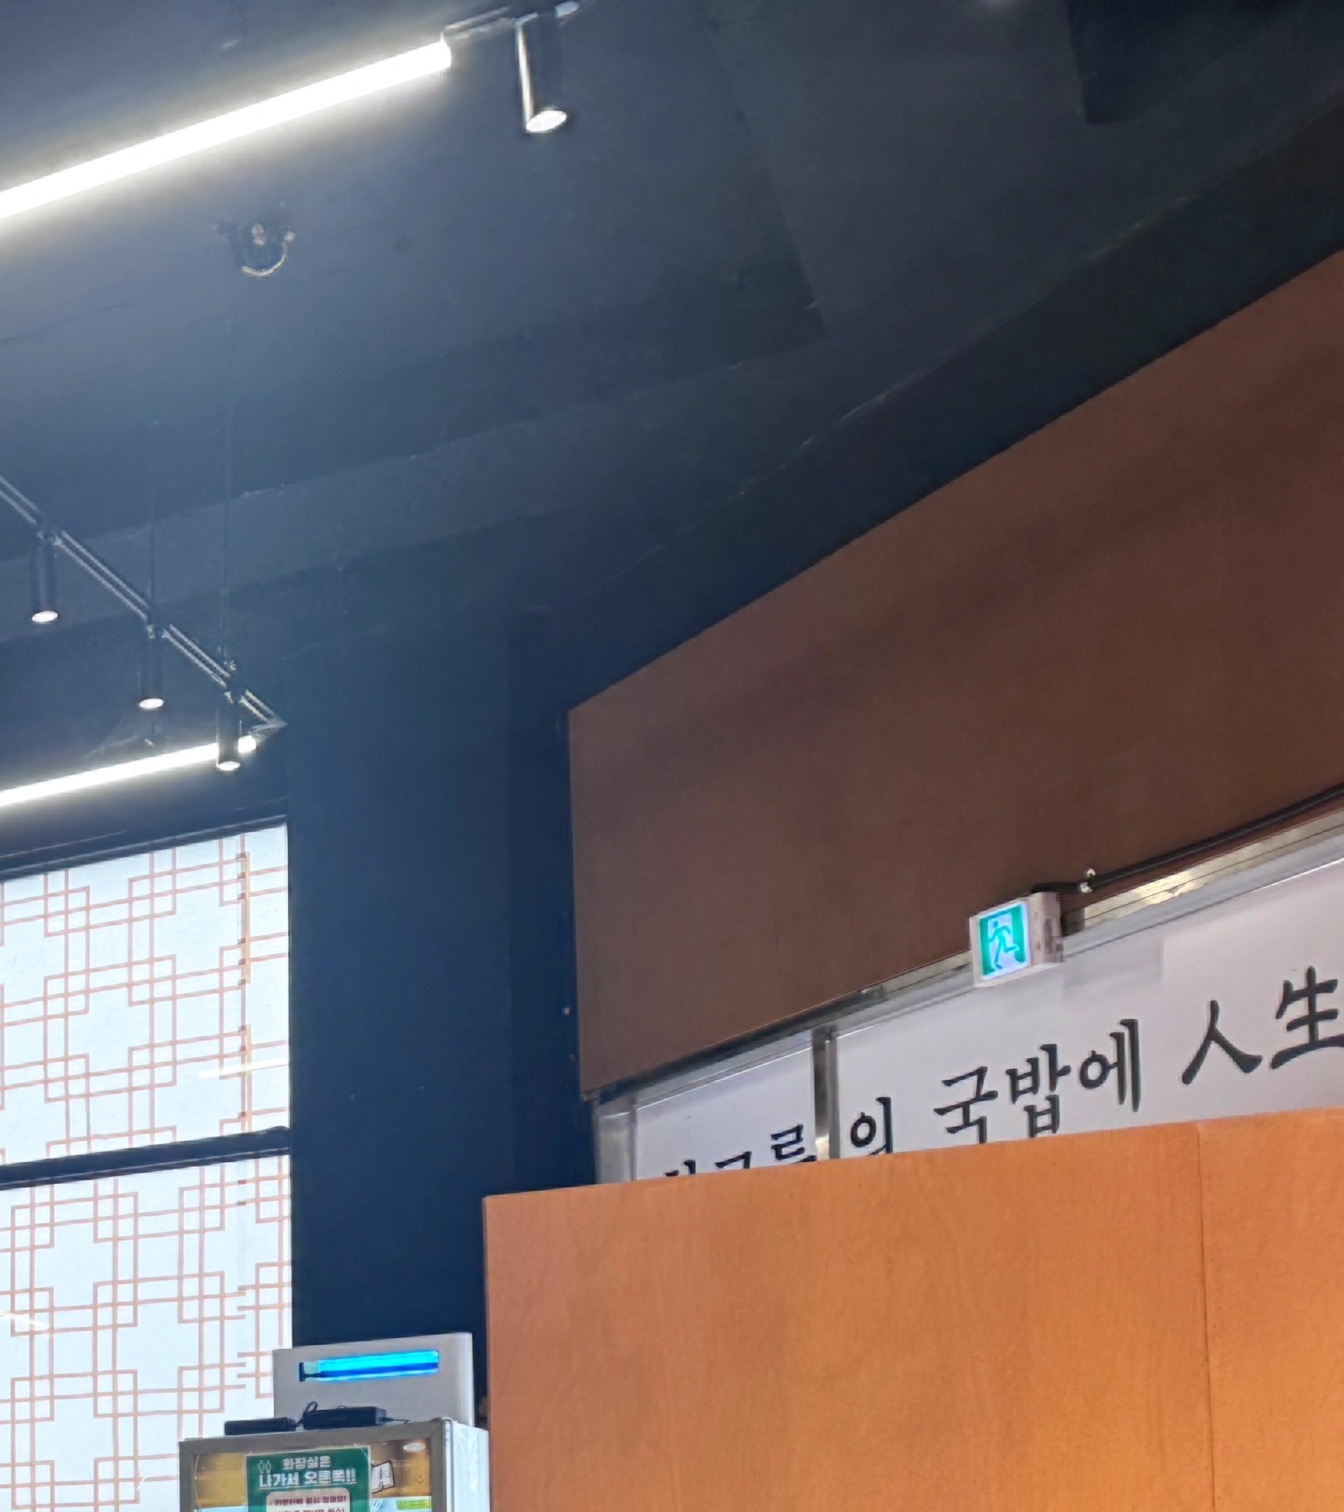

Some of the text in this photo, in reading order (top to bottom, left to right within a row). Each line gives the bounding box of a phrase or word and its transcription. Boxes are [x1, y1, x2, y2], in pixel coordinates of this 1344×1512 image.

[933, 1018, 1144, 1146] 국밥에
[1180, 965, 1344, 1086] 人生
[282, 1456, 331, 1469] 화장실은
[259, 1468, 356, 1488] 나가서 오른쪽!!
